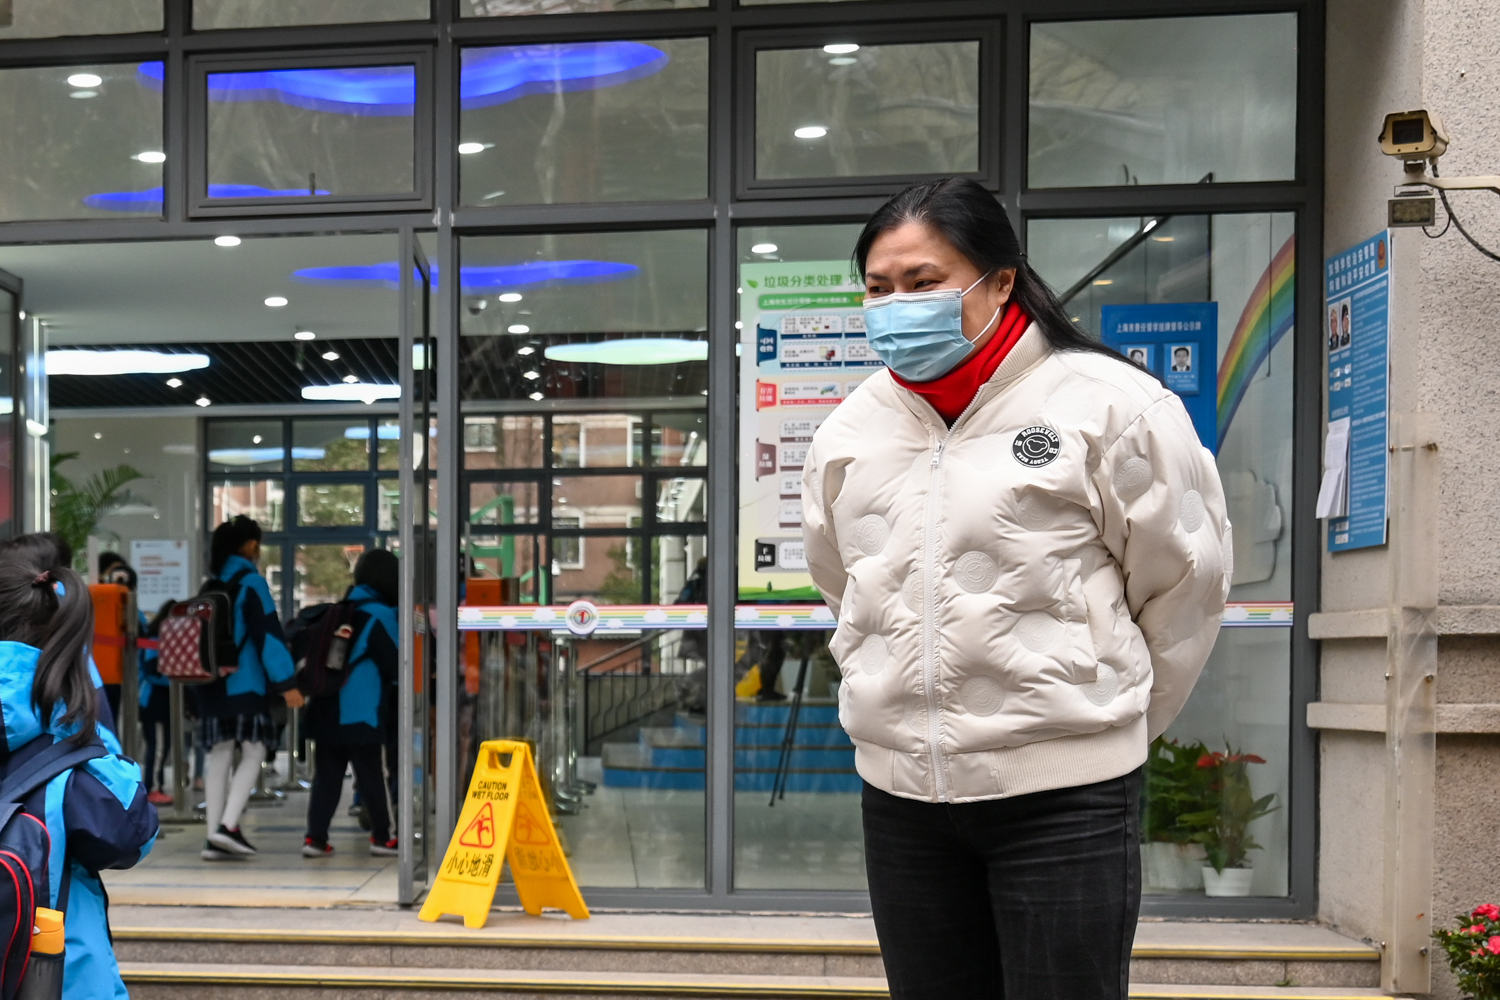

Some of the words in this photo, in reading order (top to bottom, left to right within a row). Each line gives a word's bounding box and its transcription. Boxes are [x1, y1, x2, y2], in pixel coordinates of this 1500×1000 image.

[764, 274, 842, 288] 垃圾分类处理
[1021, 427, 1059, 443] ROOSEVELT
[477, 780, 507, 790] CAUTION
[472, 791, 487, 799] WET
[487, 791, 509, 801] FLOOR
[447, 850, 495, 878] 小心地滑
